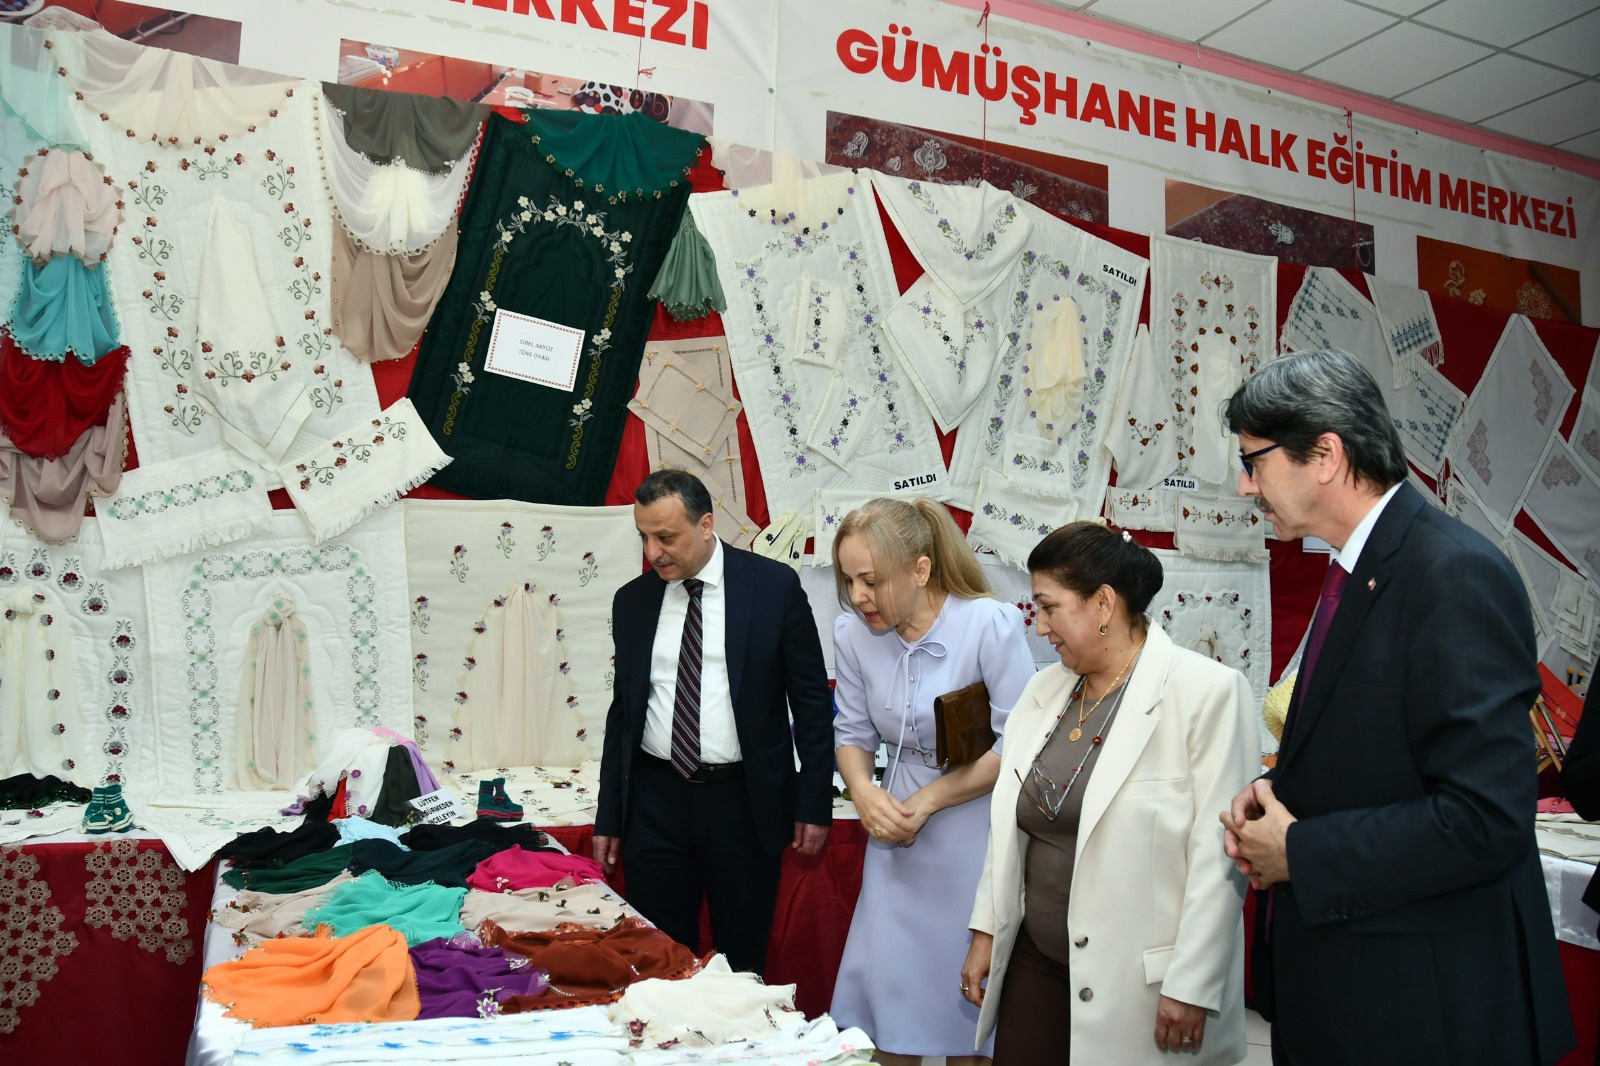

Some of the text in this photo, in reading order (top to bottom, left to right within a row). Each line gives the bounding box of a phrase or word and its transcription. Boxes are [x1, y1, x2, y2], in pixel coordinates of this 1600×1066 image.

[837, 24, 1577, 239] GÜMÜŞHANE HALK EĞİTİM MERKEZİ
[1102, 264, 1137, 287] SATILDI
[893, 473, 937, 490] SATILDI
[1164, 478, 1195, 489] SATILDI
[417, 794, 440, 807] LÜTFEN
